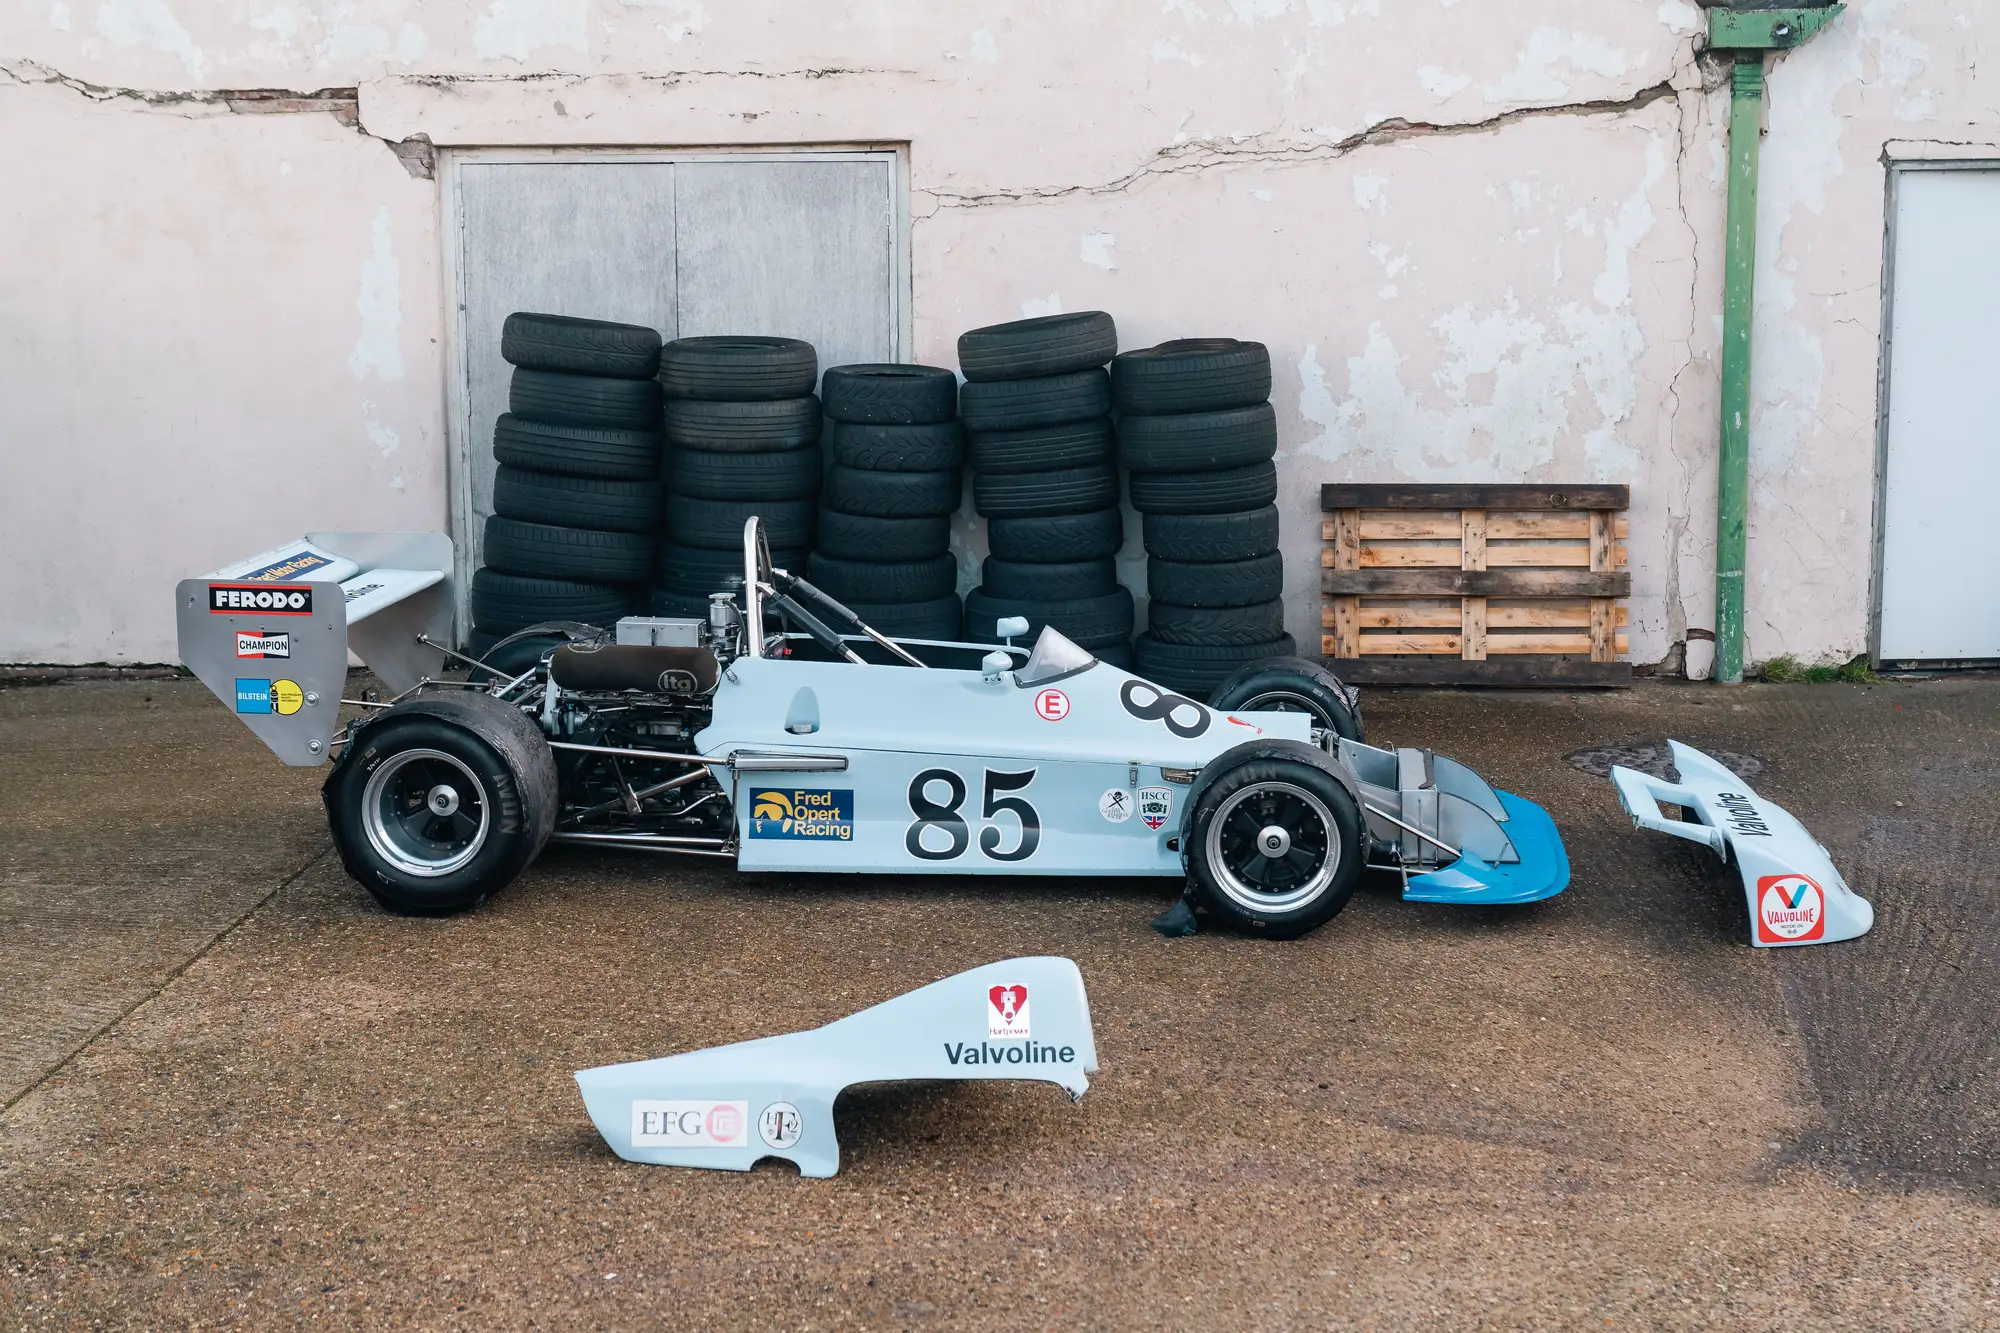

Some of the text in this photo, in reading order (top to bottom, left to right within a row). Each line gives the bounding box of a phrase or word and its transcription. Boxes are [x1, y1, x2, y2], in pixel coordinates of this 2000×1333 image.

[215, 590, 306, 609] FERODO
[239, 640, 287, 651] CHAMPION
[237, 692, 268, 701] BILSTEIN
[1045, 694, 1061, 714] E
[794, 791, 831, 806] Fred
[1141, 791, 1170, 801] HSCC
[793, 806, 840, 824] Opert
[904, 766, 1042, 862] 85
[1714, 792, 1773, 837] Valvoline
[793, 821, 851, 840] Racing
[1767, 908, 1814, 925] VALVOLINE
[944, 1041, 1075, 1065] Valvoline
[640, 1111, 702, 1136] EFG
